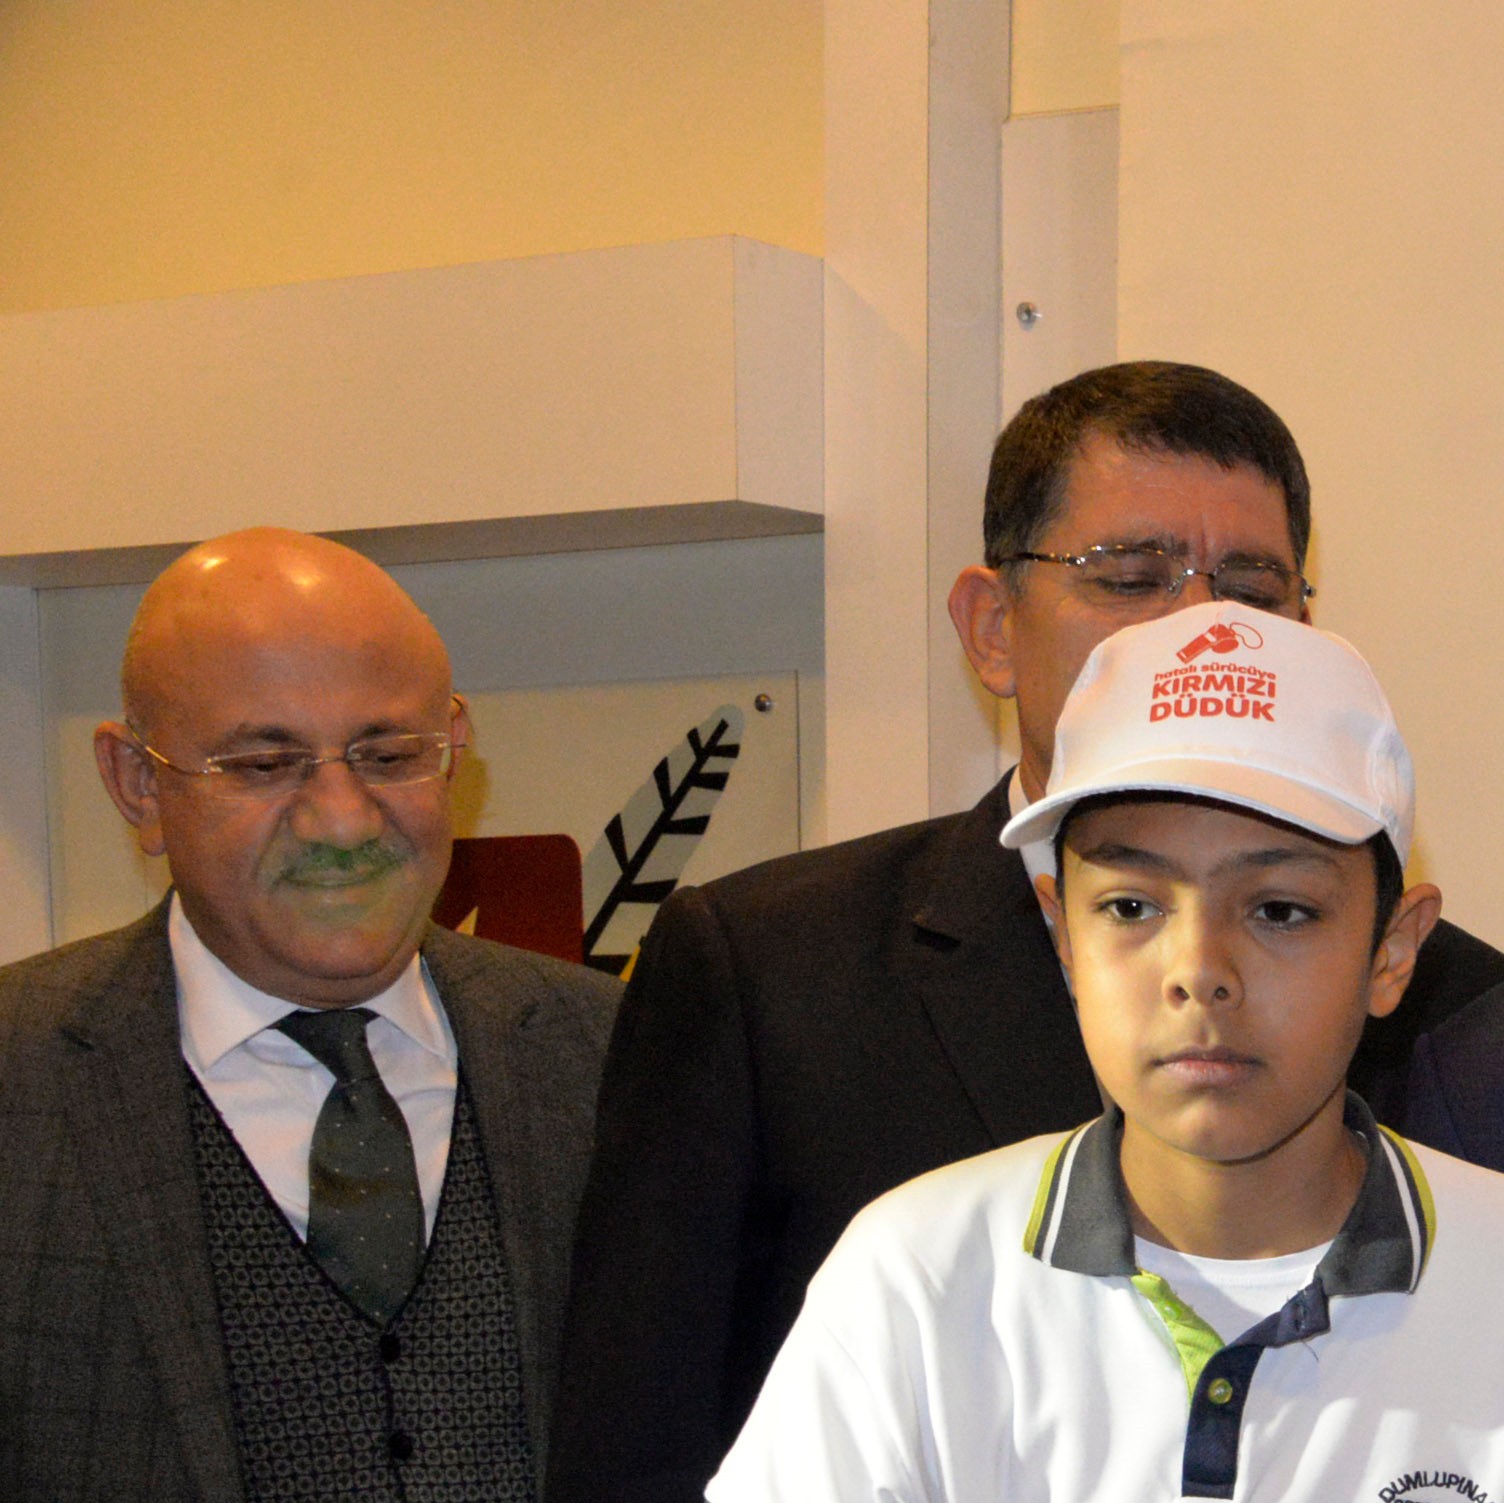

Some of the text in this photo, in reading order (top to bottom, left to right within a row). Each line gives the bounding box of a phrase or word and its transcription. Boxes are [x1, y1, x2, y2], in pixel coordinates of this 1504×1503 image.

[1154, 661, 1276, 680] hatalı sürücüye
[1151, 674, 1276, 699] KIRMIZI
[1150, 693, 1275, 722] DÜDÜK
